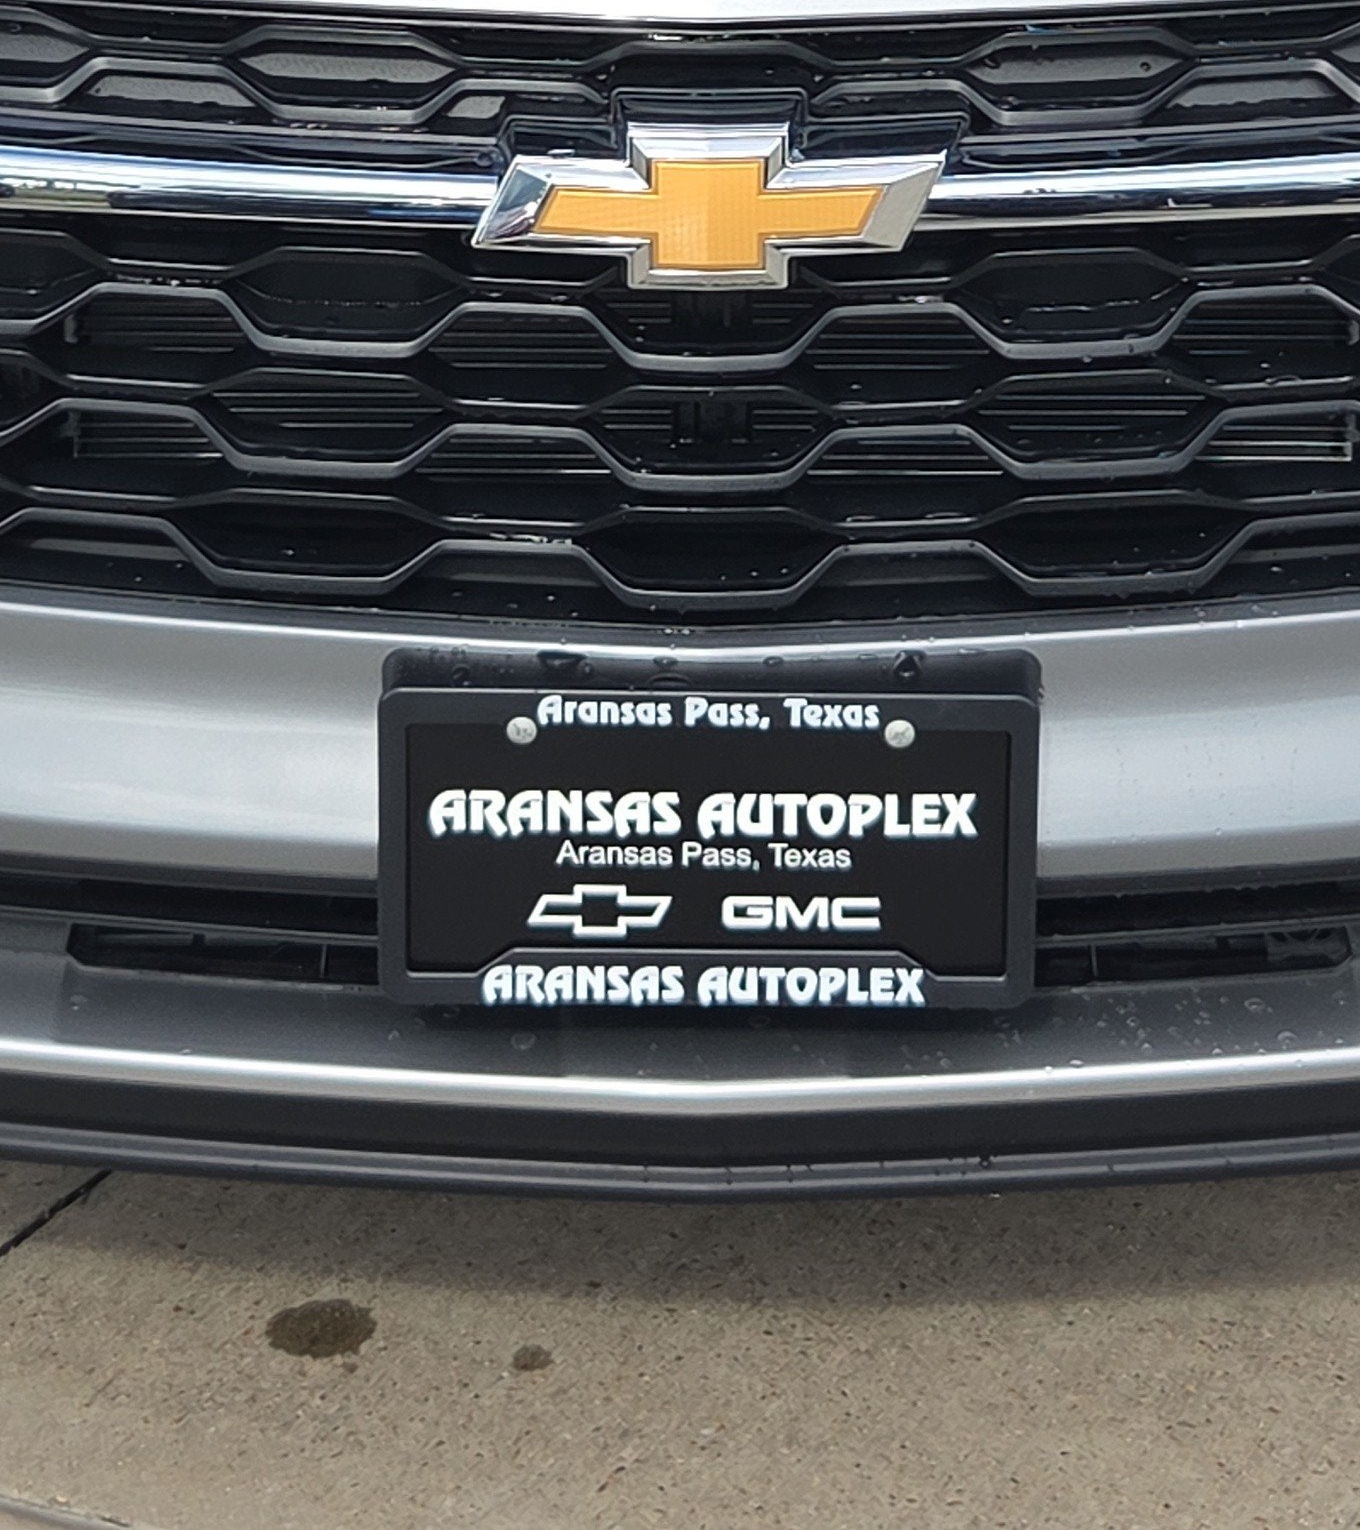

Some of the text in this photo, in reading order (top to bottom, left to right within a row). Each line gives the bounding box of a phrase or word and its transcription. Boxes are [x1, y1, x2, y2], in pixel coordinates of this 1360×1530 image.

[537, 695, 880, 730] Aransas Pass, Texas
[428, 789, 978, 839] ARANSAS AUTOPLEX
[556, 840, 852, 871] Aransas Pass, Texas
[721, 895, 882, 930] GMC
[482, 964, 926, 1008] ARANSAS AUTOPLEX
